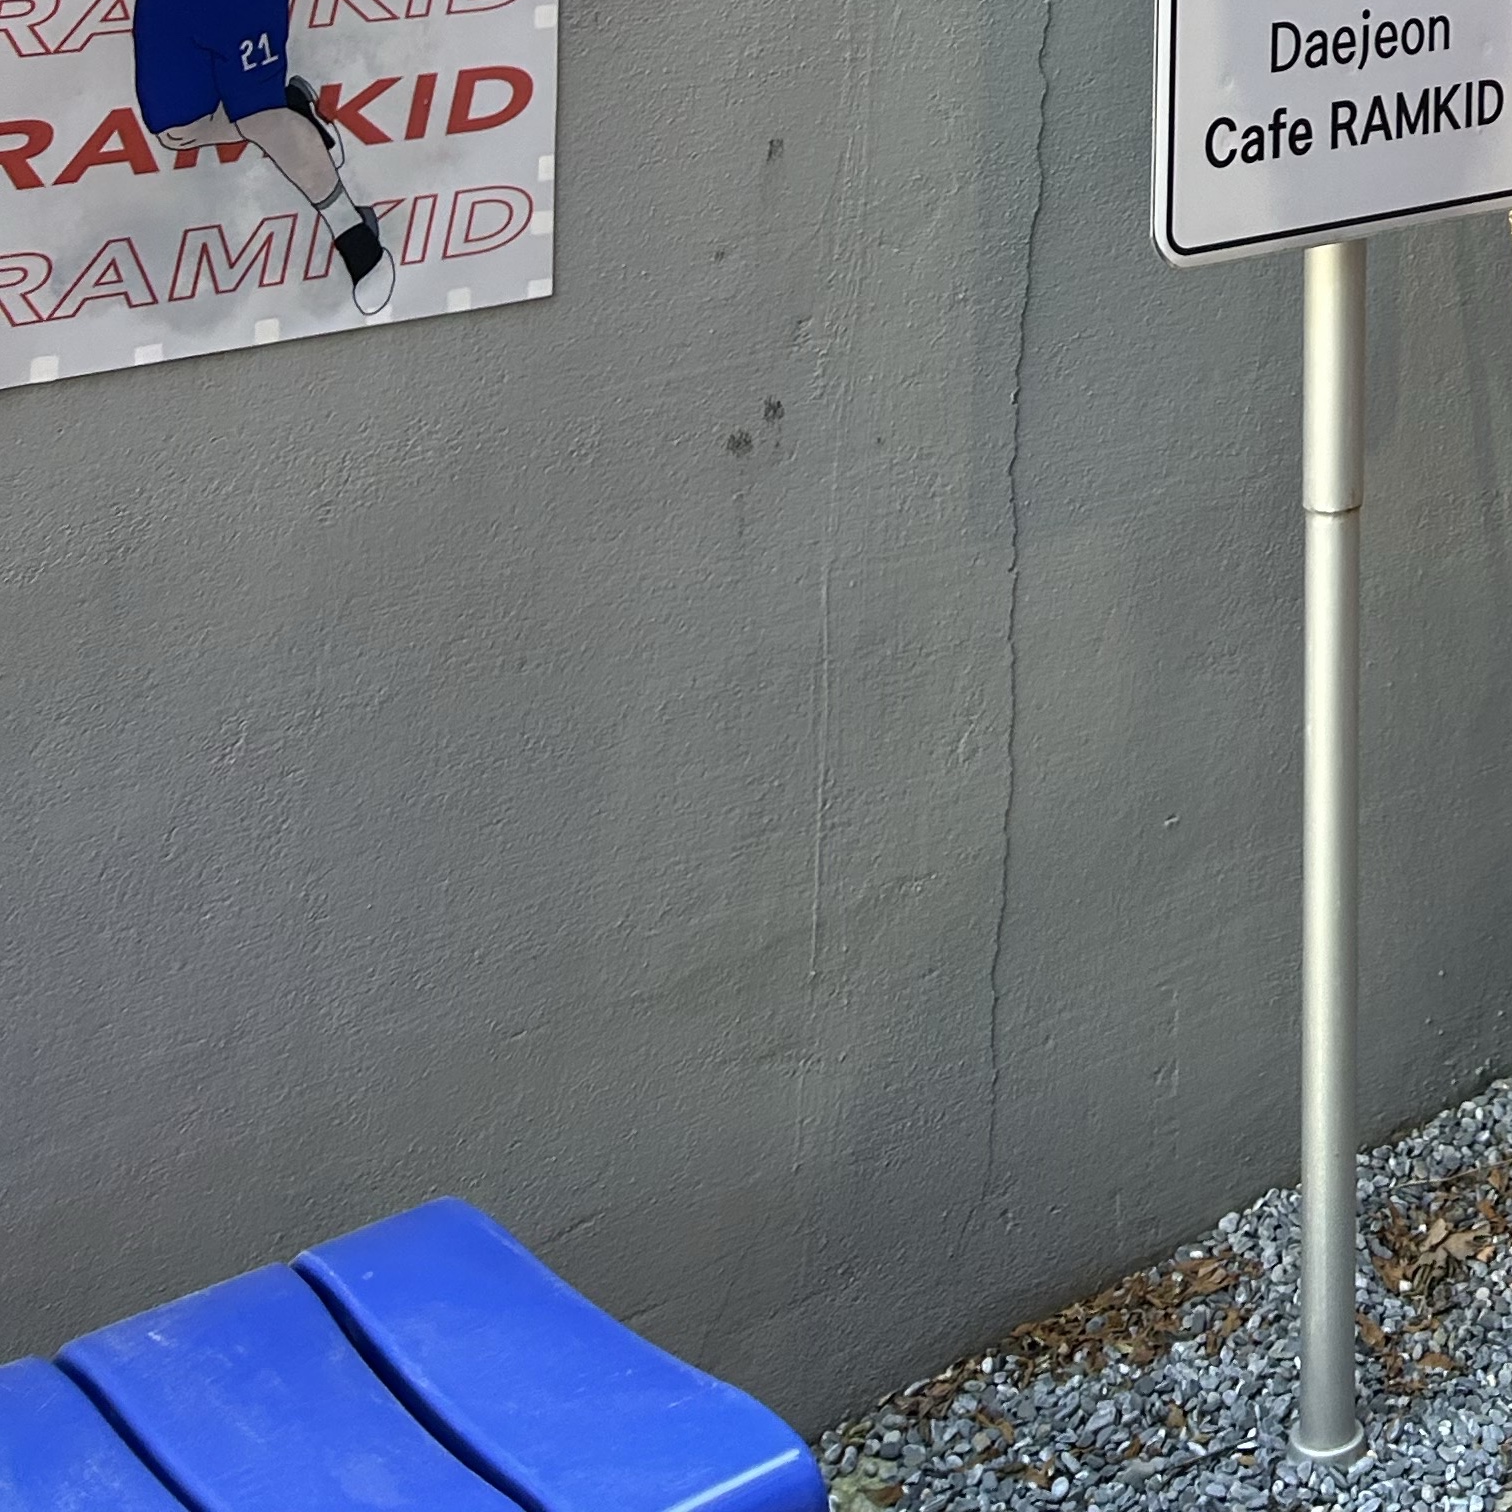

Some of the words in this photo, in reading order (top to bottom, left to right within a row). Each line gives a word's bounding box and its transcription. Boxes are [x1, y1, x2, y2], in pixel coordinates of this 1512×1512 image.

[239, 32, 279, 72] 21
[1270, 10, 1451, 73] Daejeon
[0, 65, 535, 190] RAKID
[1205, 106, 1314, 169] Cafe
[1329, 78, 1505, 150] RAMKID
